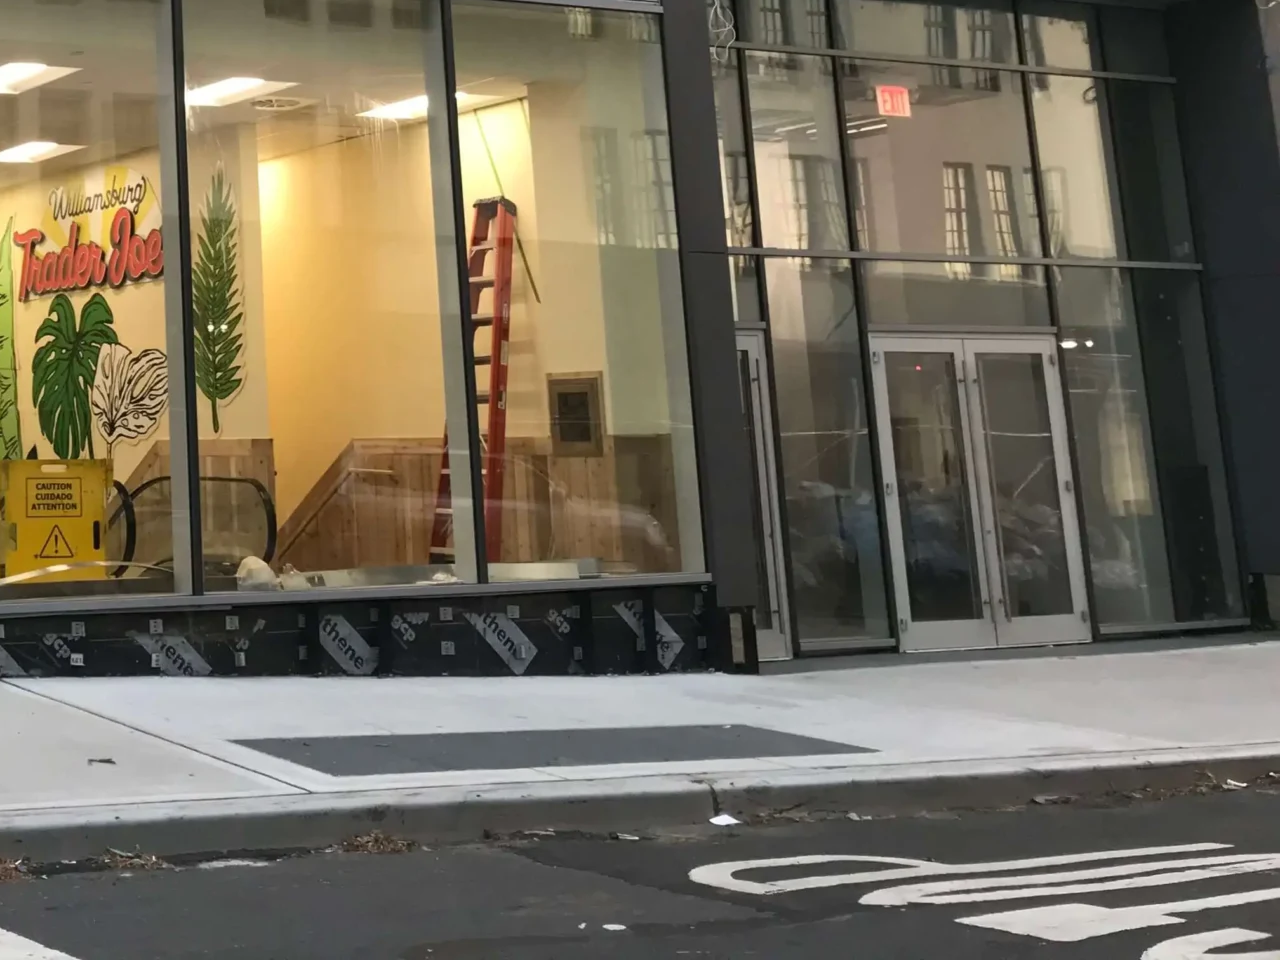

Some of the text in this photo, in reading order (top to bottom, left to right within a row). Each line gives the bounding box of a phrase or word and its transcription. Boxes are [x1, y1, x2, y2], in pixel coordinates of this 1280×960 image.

[881, 87, 907, 114] EXIT
[49, 175, 148, 221] Williamsburg
[14, 220, 108, 302] Trader
[35, 482, 72, 491] CAUTION
[35, 493, 73, 501] CUIDADO
[31, 503, 77, 511] ATTENTION
